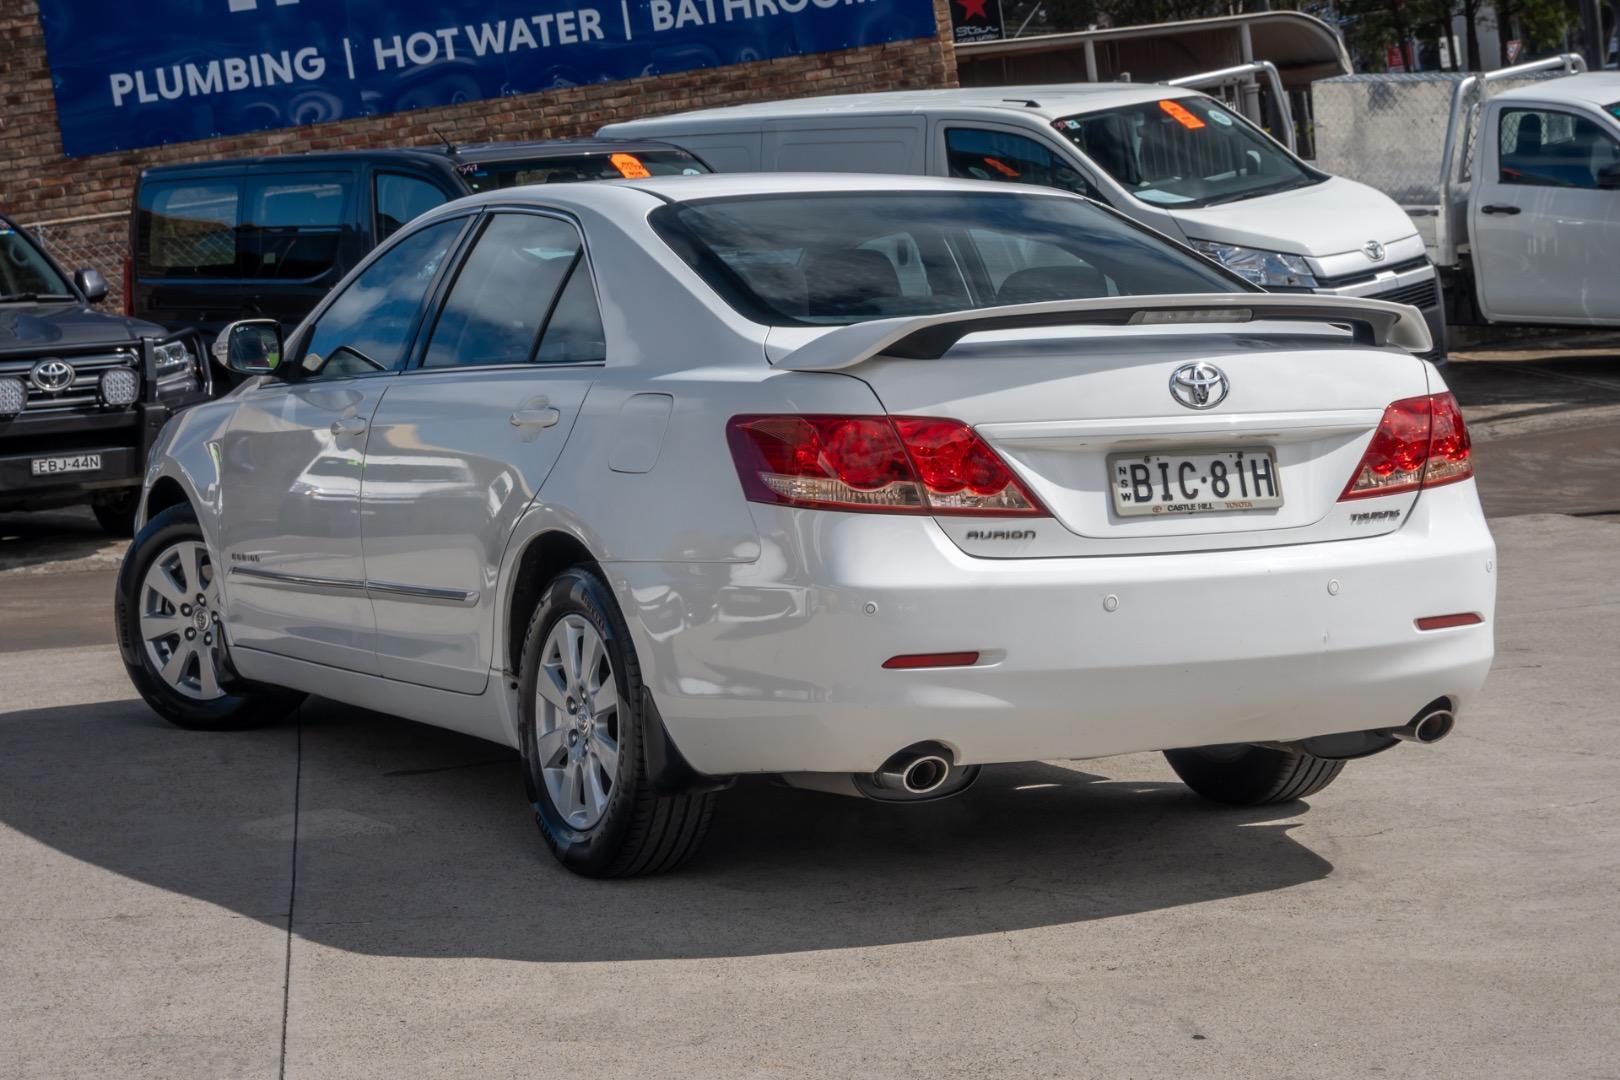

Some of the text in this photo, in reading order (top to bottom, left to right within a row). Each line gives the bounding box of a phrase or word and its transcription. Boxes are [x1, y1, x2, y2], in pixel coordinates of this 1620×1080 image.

[110, 47, 326, 107] PLUMBING
[373, 27, 459, 71] HOT
[465, 8, 604, 56] WATER
[1167, 504, 1196, 512] CASTLE
[1225, 501, 1253, 509] TOYOTA
[967, 530, 1036, 540] AURION
